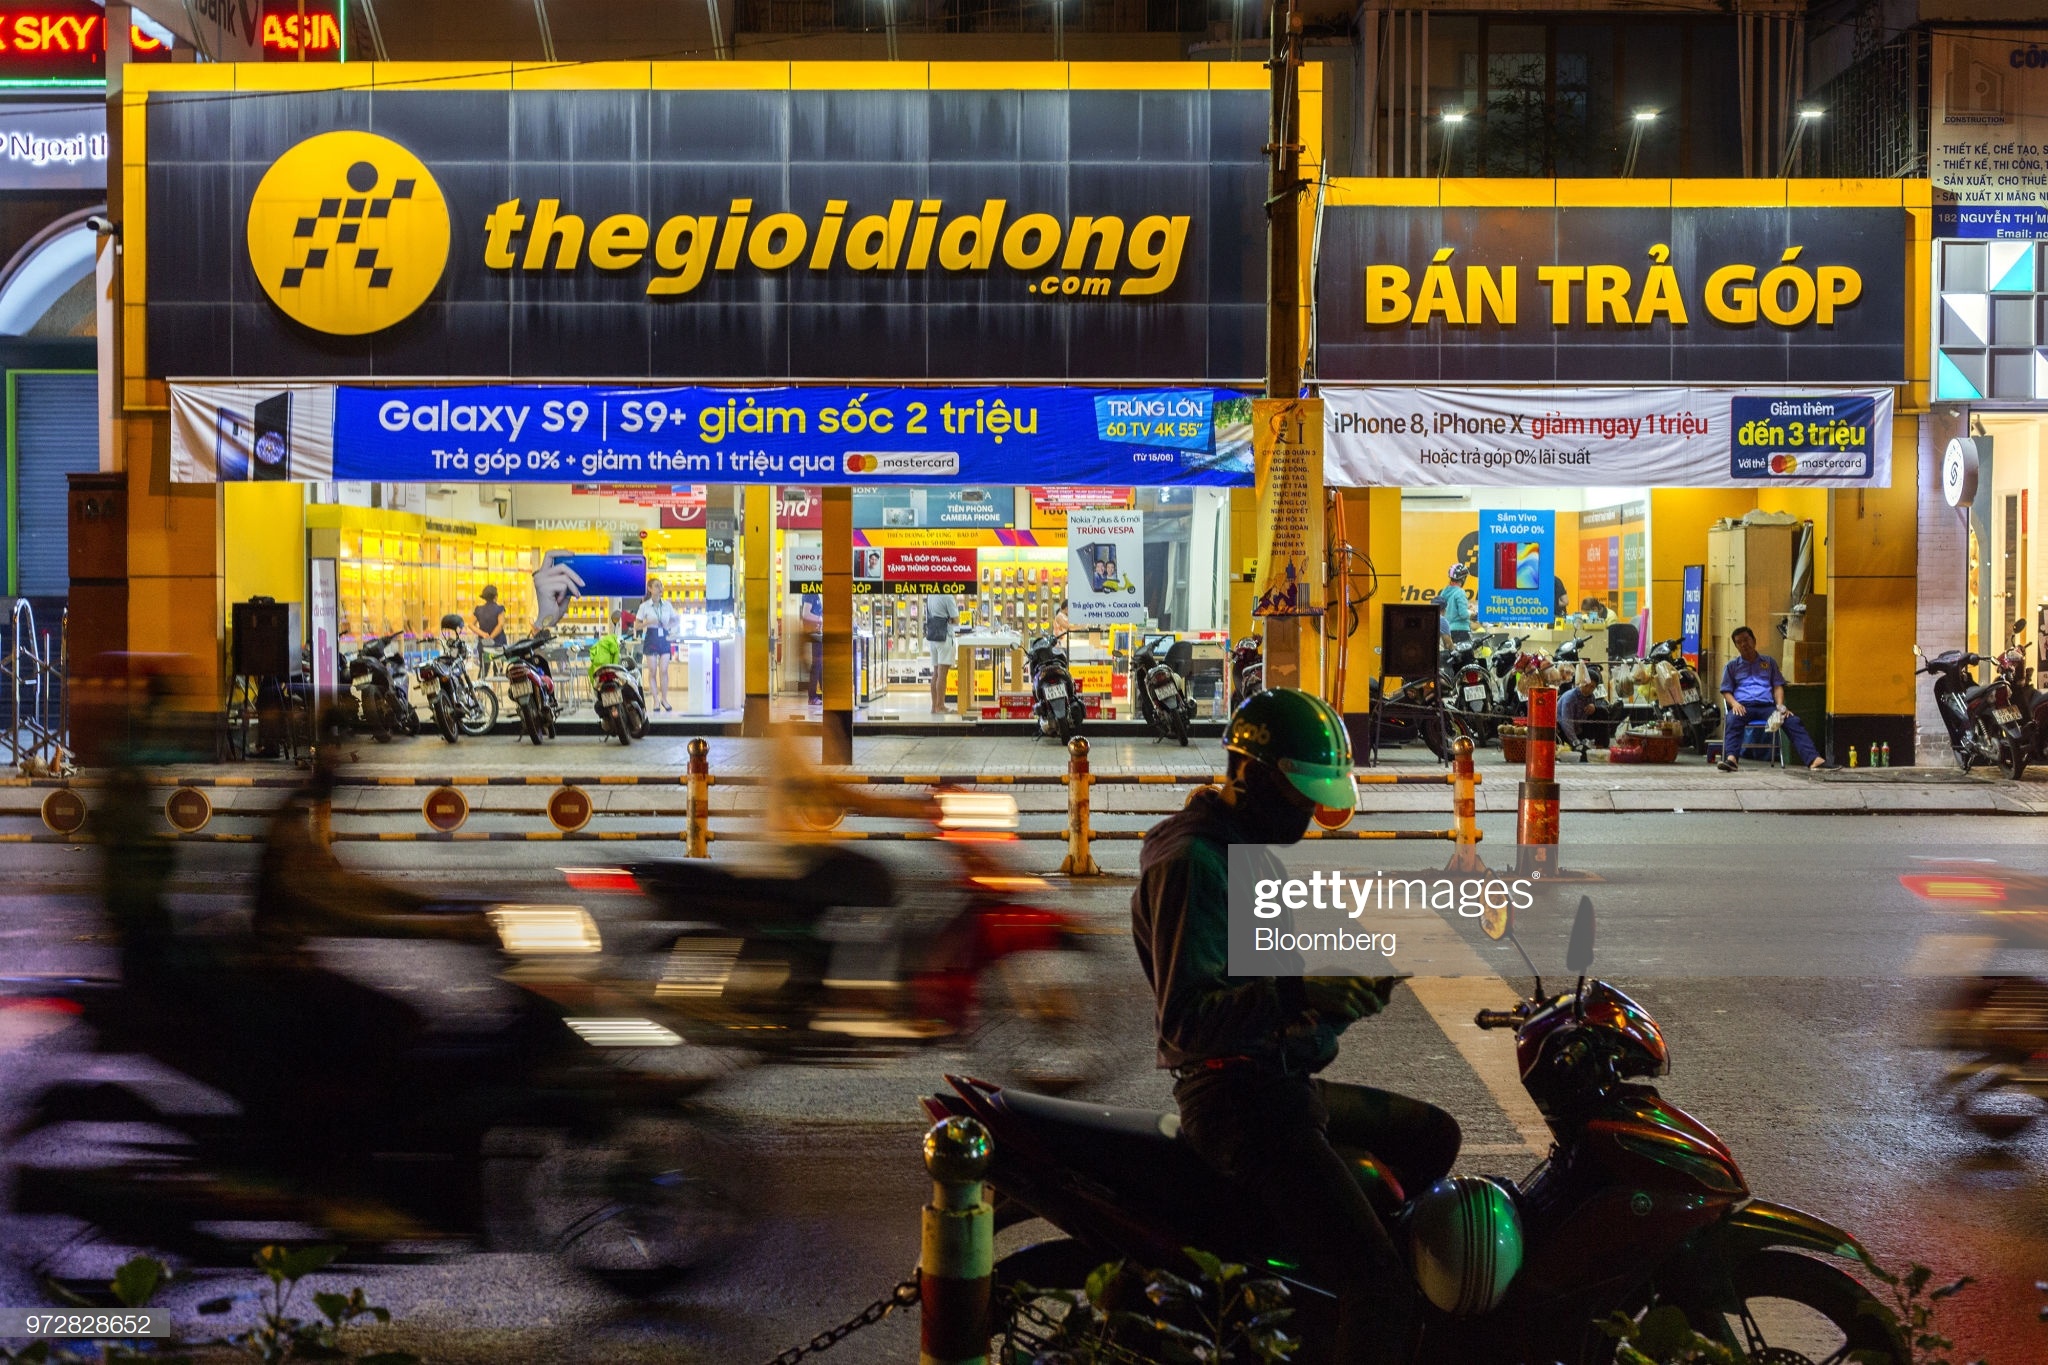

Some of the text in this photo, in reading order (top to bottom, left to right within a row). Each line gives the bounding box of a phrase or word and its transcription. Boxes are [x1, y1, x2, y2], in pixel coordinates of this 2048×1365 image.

[195, 0, 236, 37] bank
[13, 16, 97, 50] SKY
[263, 14, 341, 49] ASIN
[11, 133, 85, 165] Ngoại
[1943, 142, 2040, 156] THIẾT KẾ, CHẾ TẠO,
[1943, 157, 1971, 170] THIẾT
[1994, 160, 2008, 170] THI
[1944, 173, 1964, 185] SẢN
[1998, 176, 2018, 185] CHO
[2022, 174, 2047, 185] THUÊ
[1942, 189, 2036, 201] SẢN XUẤT XI MĂNG
[1938, 210, 2034, 224] 182 NGUYỄN THỊ
[1996, 229, 2032, 238] Email:
[484, 198, 1191, 296] thegioididong
[1029, 275, 1111, 296] .com
[1365, 242, 1863, 327] BÁN TRẢ GÓP
[1108, 396, 1203, 417] TRÚNG LỚN
[1770, 401, 1834, 416] Giảm thêm
[378, 392, 1038, 444] Galaxy S9 S9+ giảm sốc 2 triệu
[1106, 422, 1127, 437] 60
[1130, 422, 1152, 437] TV
[1154, 422, 1176, 437] 4K
[1334, 411, 1708, 440] iPhone 8, iPhone X giảm ngay 1 triệu
[1738, 418, 1866, 452] đến 3 triệu
[432, 448, 469, 470] Trả
[474, 448, 522, 476] góp
[527, 450, 560, 470] 0%
[582, 448, 642, 476] giảm
[648, 449, 710, 470] thêm
[716, 452, 724, 470] 1
[730, 449, 784, 477] triệu
[789, 455, 835, 478] qua
[883, 457, 954, 468] mastercard
[1420, 447, 1591, 468] Hoặc trả góp 0% lãi suất
[1738, 457, 1862, 469] Với thẻ mastercard
[940, 514, 1000, 522] CAMERA PHONE
[1070, 516, 1091, 524] Nokia
[1098, 516, 1112, 524] plus
[1518, 514, 1537, 522] Vivo
[535, 520, 639, 532] HUAWEI P20 Pro
[1076, 525, 1134, 534] TRÚNG VESPA
[1490, 524, 1544, 534] TRẢ GÓP 0%
[708, 538, 724, 547] Pro
[900, 554, 913, 563] TRẢ
[914, 554, 930, 563] GÓP
[794, 564, 817, 572] TRÚNG
[801, 580, 822, 594] BÁN
[895, 582, 966, 594] BÁN TRẢ GÓP
[1486, 606, 1548, 614] PMH 300.000
